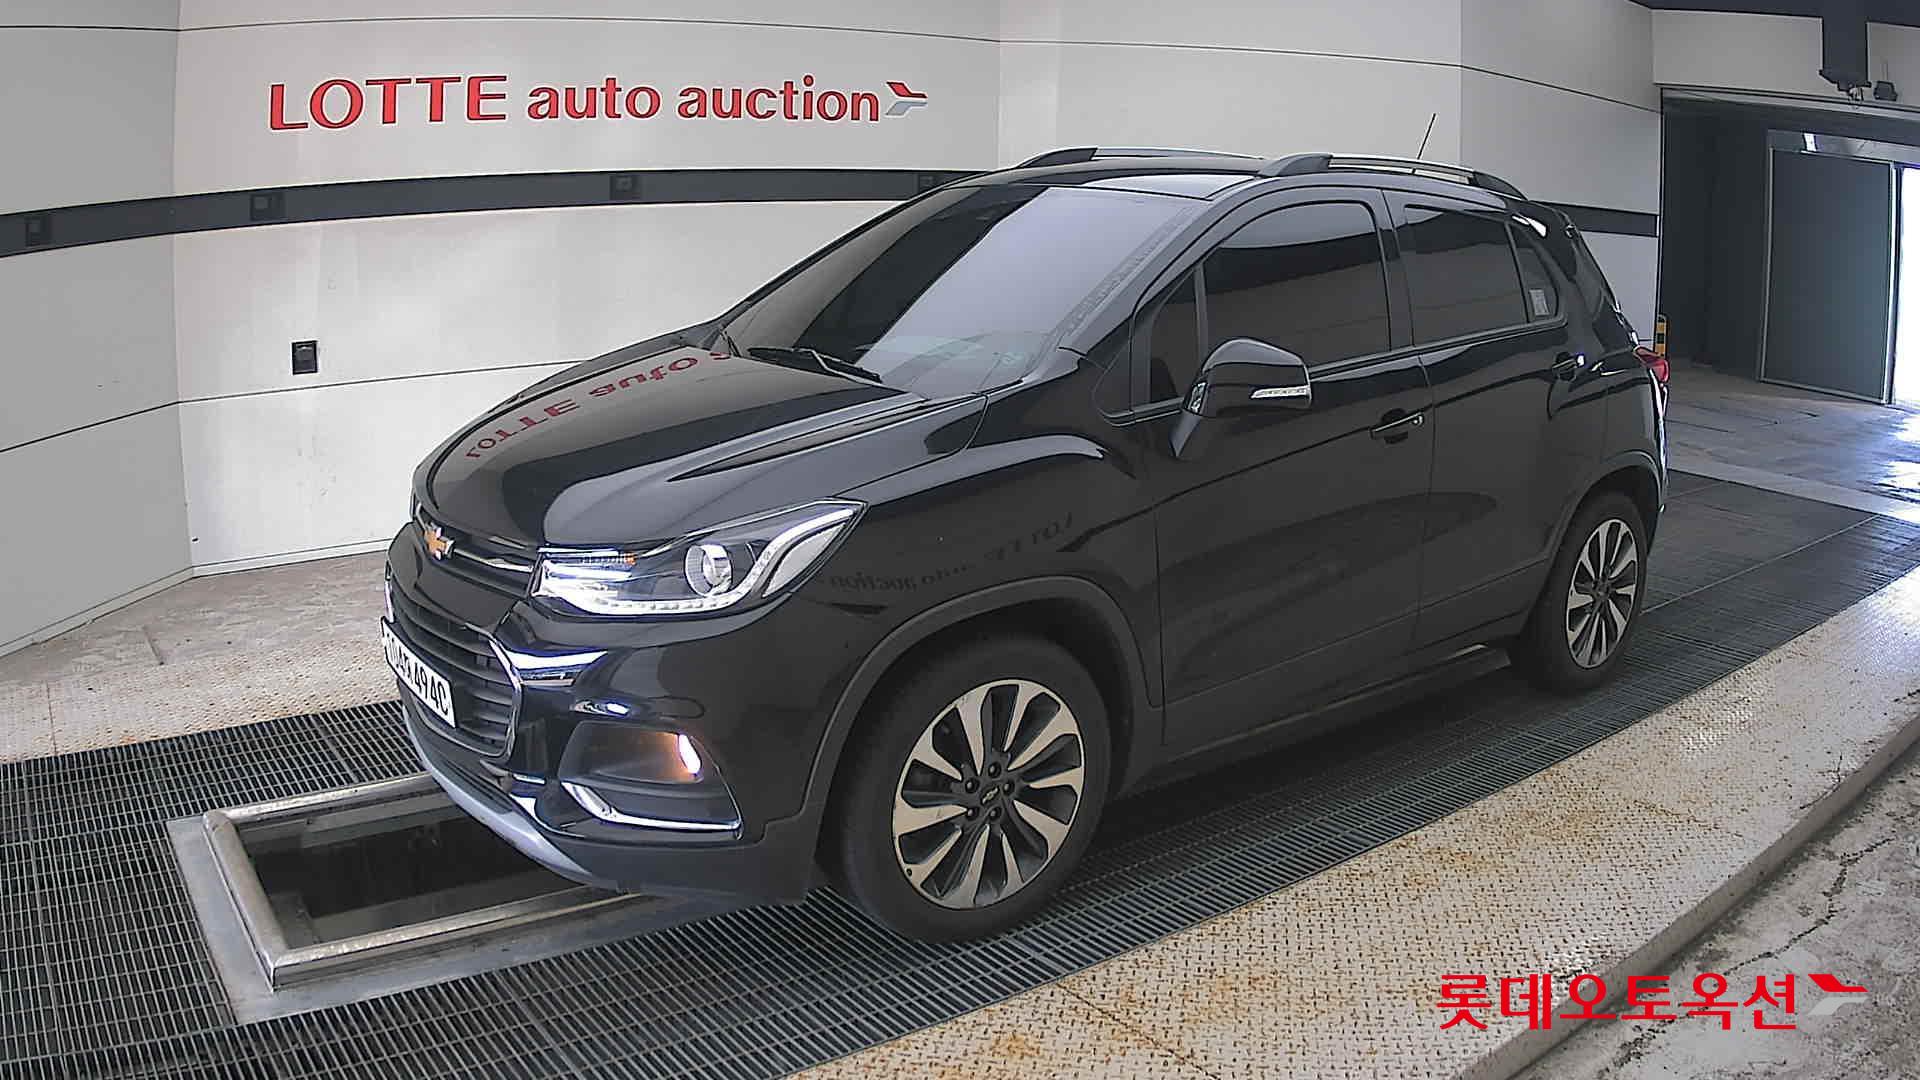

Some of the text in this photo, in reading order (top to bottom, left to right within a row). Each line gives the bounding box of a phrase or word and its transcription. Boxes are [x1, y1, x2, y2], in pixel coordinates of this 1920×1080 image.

[269, 74, 880, 131] LOTTE auto auction
